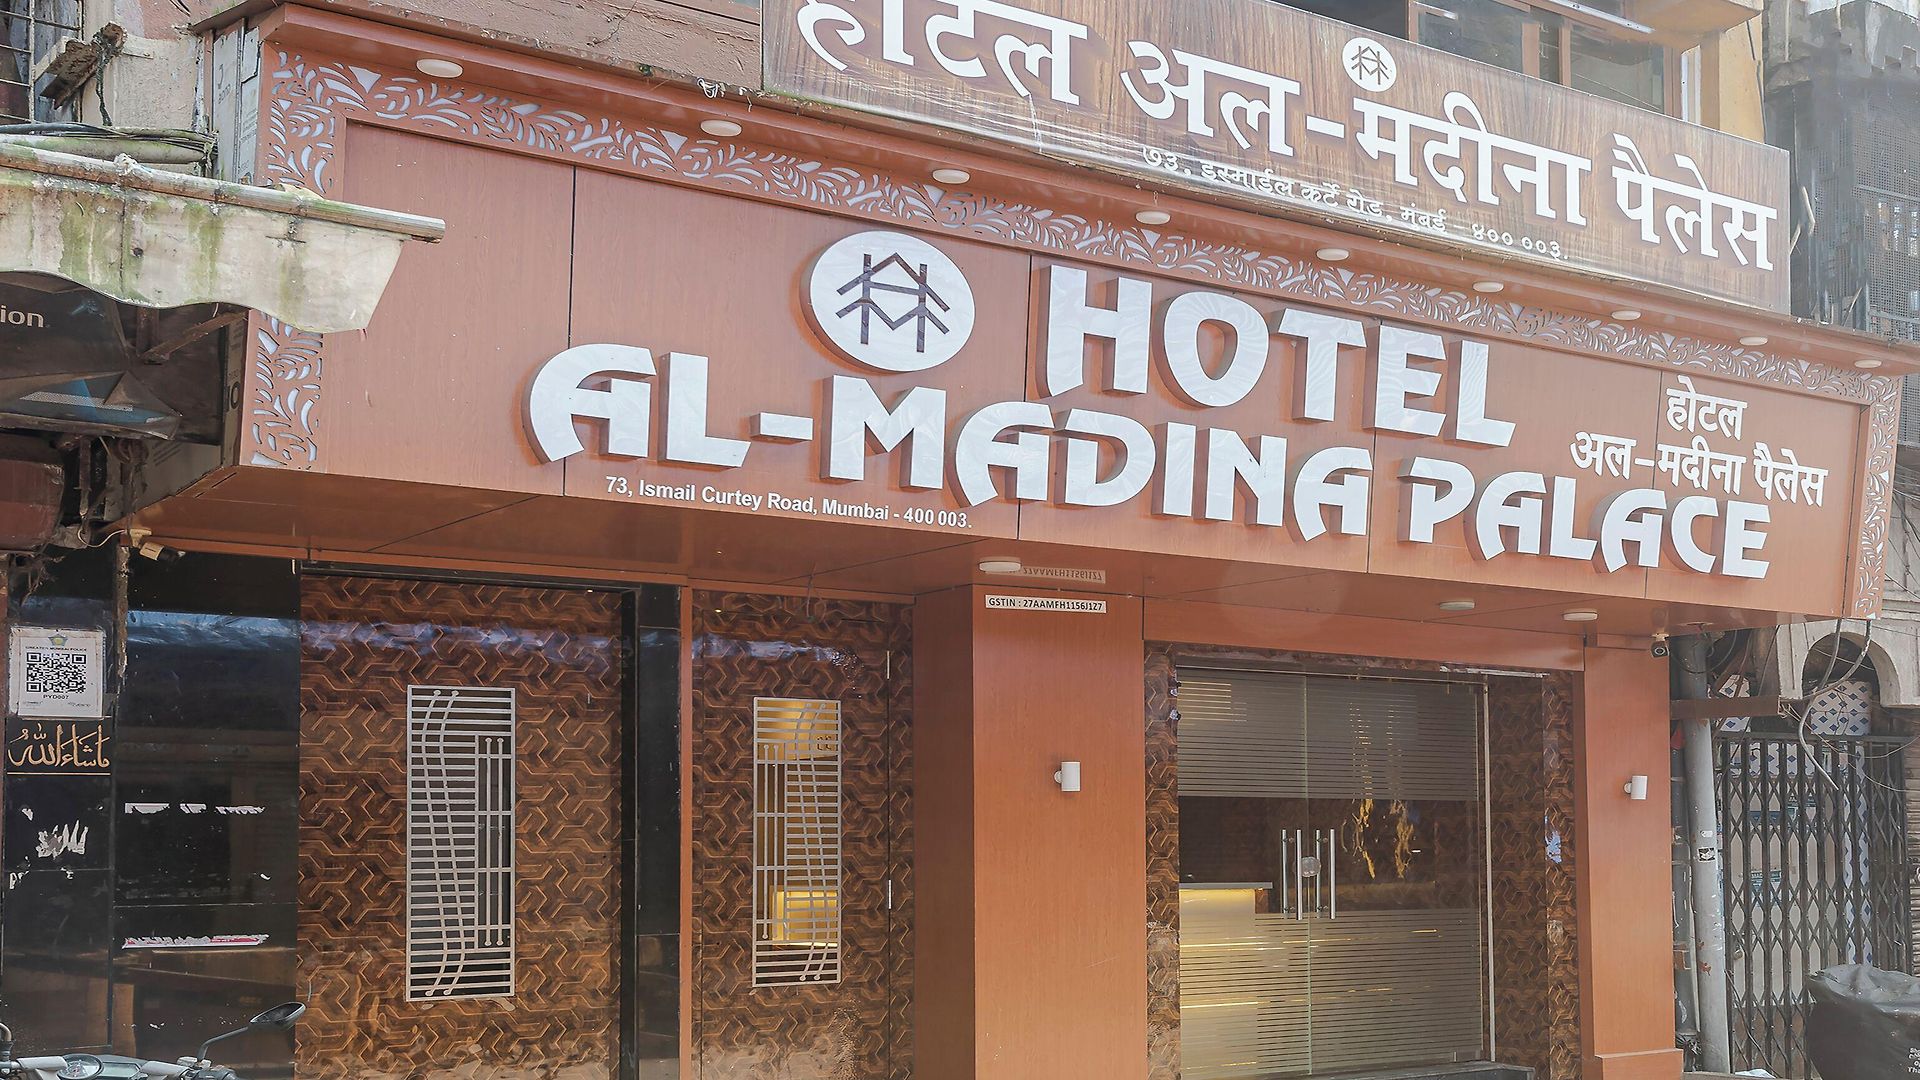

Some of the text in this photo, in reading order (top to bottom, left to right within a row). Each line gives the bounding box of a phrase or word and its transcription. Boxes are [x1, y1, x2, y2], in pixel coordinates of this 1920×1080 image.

[1610, 132, 1778, 271] पैलेस
[1044, 263, 1516, 448] HOTEL
[1666, 374, 1747, 441] होटल
[527, 342, 1771, 580] AL-MADINA PALACE
[1753, 441, 1829, 507] पैलेस
[605, 475, 634, 498] 73,
[639, 479, 696, 502] Ismail
[701, 485, 763, 511] Curtey
[767, 492, 818, 515] Road,
[822, 498, 889, 521] Mumbai
[988, 597, 1016, 608] GSTIN
